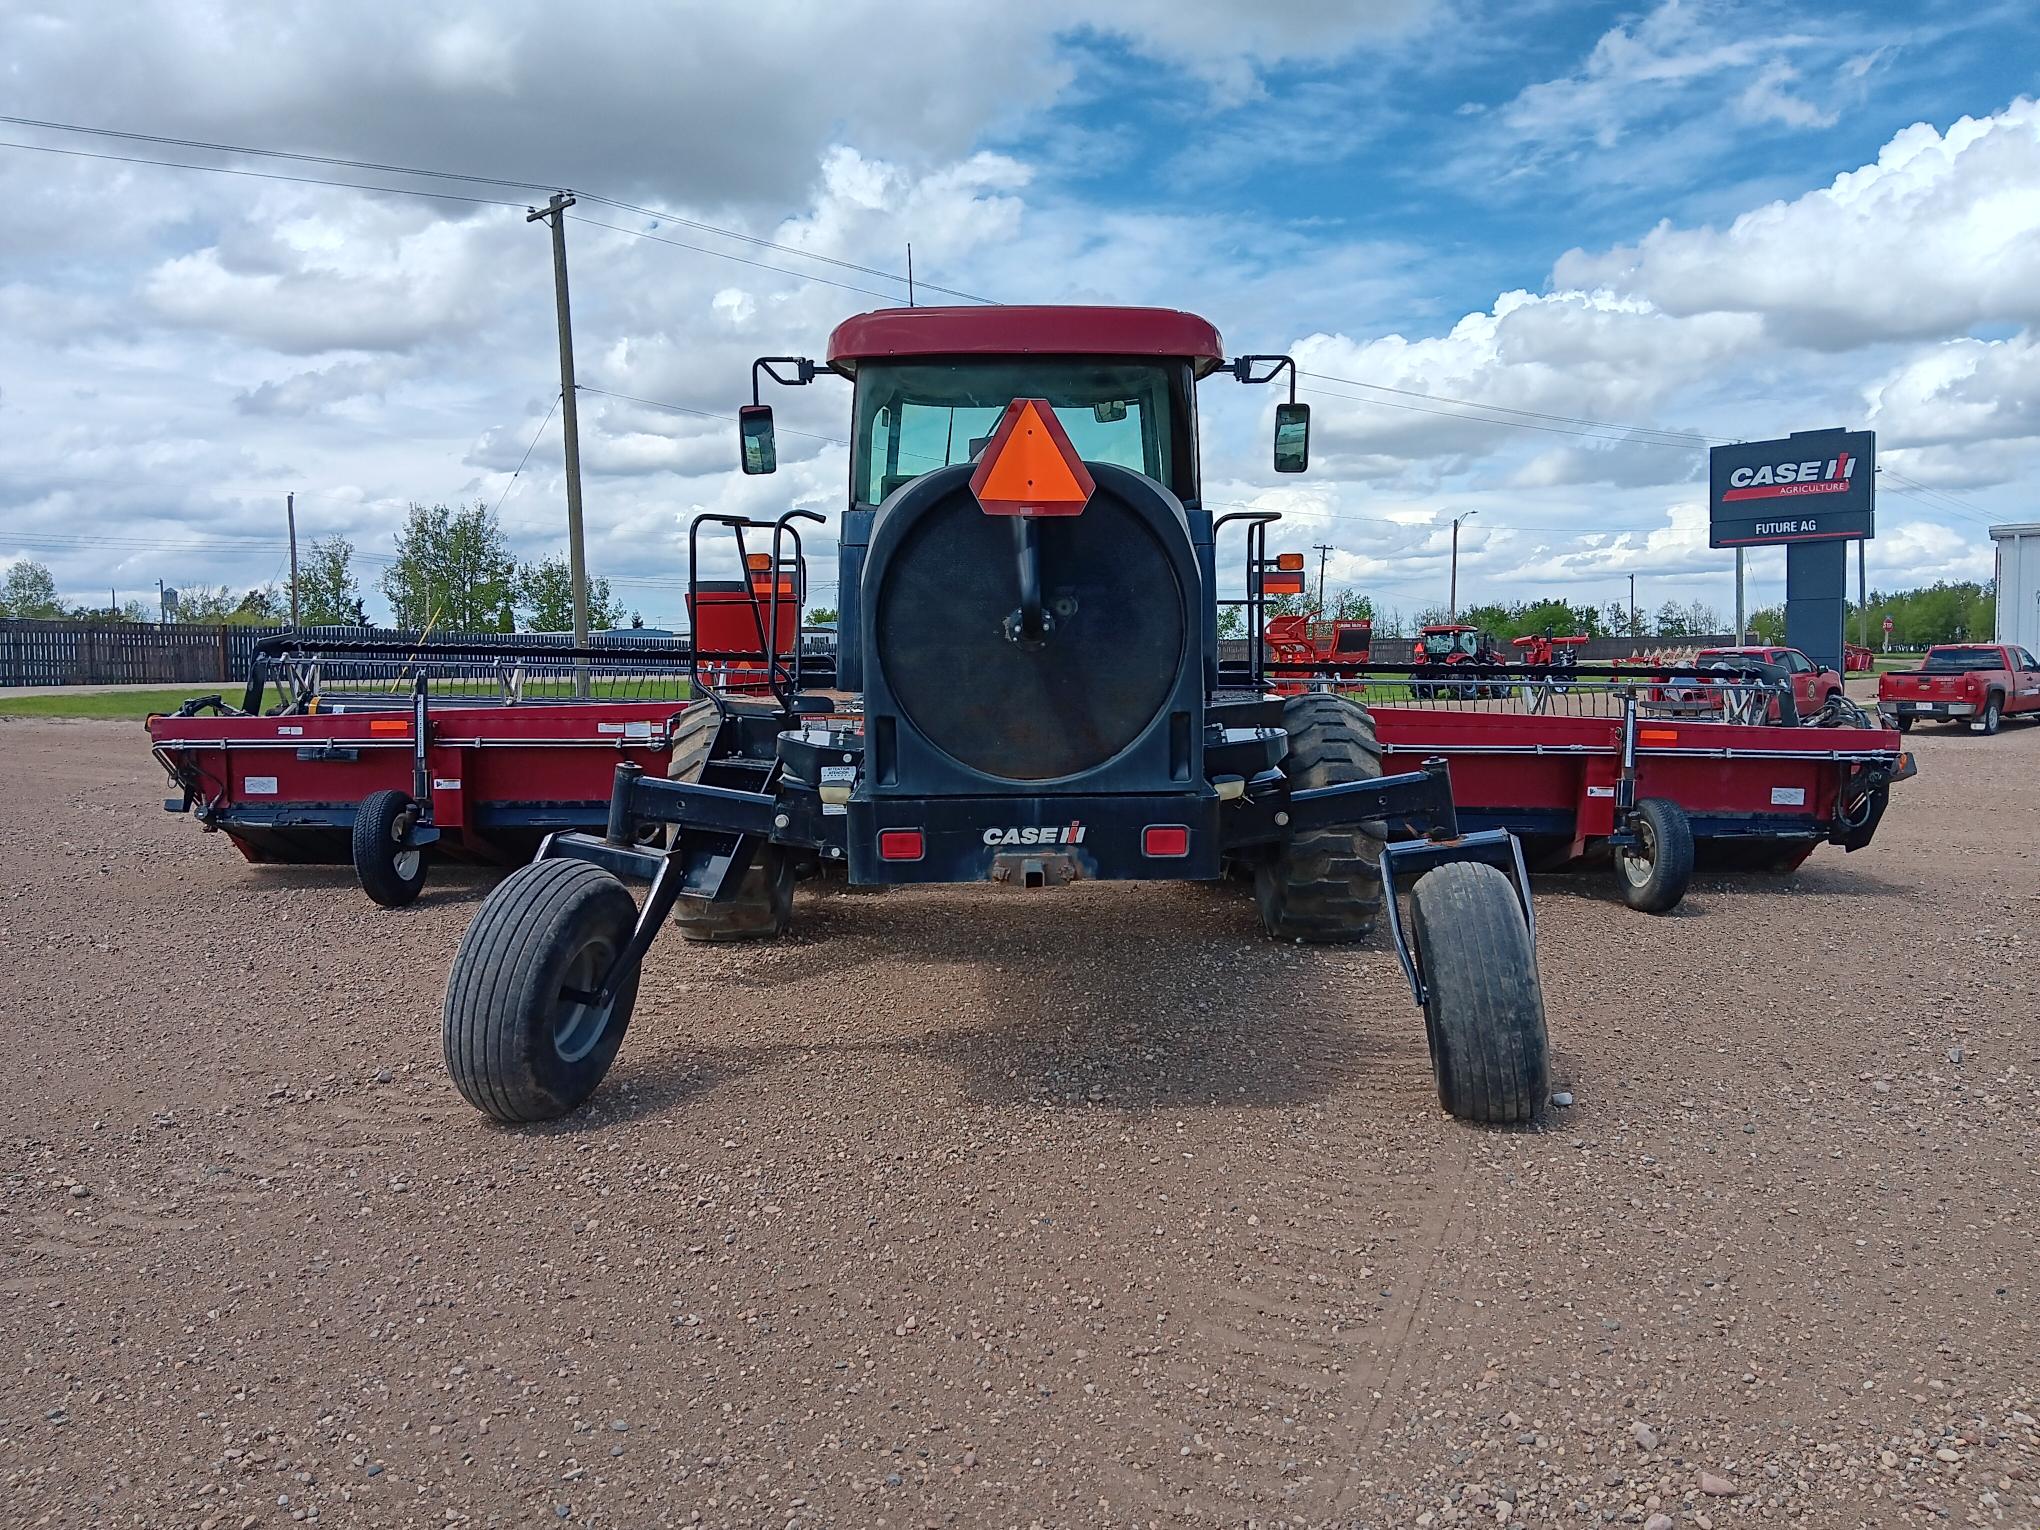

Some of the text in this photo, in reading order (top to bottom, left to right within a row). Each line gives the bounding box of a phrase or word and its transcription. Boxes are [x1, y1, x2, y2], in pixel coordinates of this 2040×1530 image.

[1730, 460, 1822, 488] CASE
[1780, 482, 1845, 494] AGRICULTURE
[1755, 519, 1817, 535] FUTURE AG
[982, 827, 1059, 845] CASE
